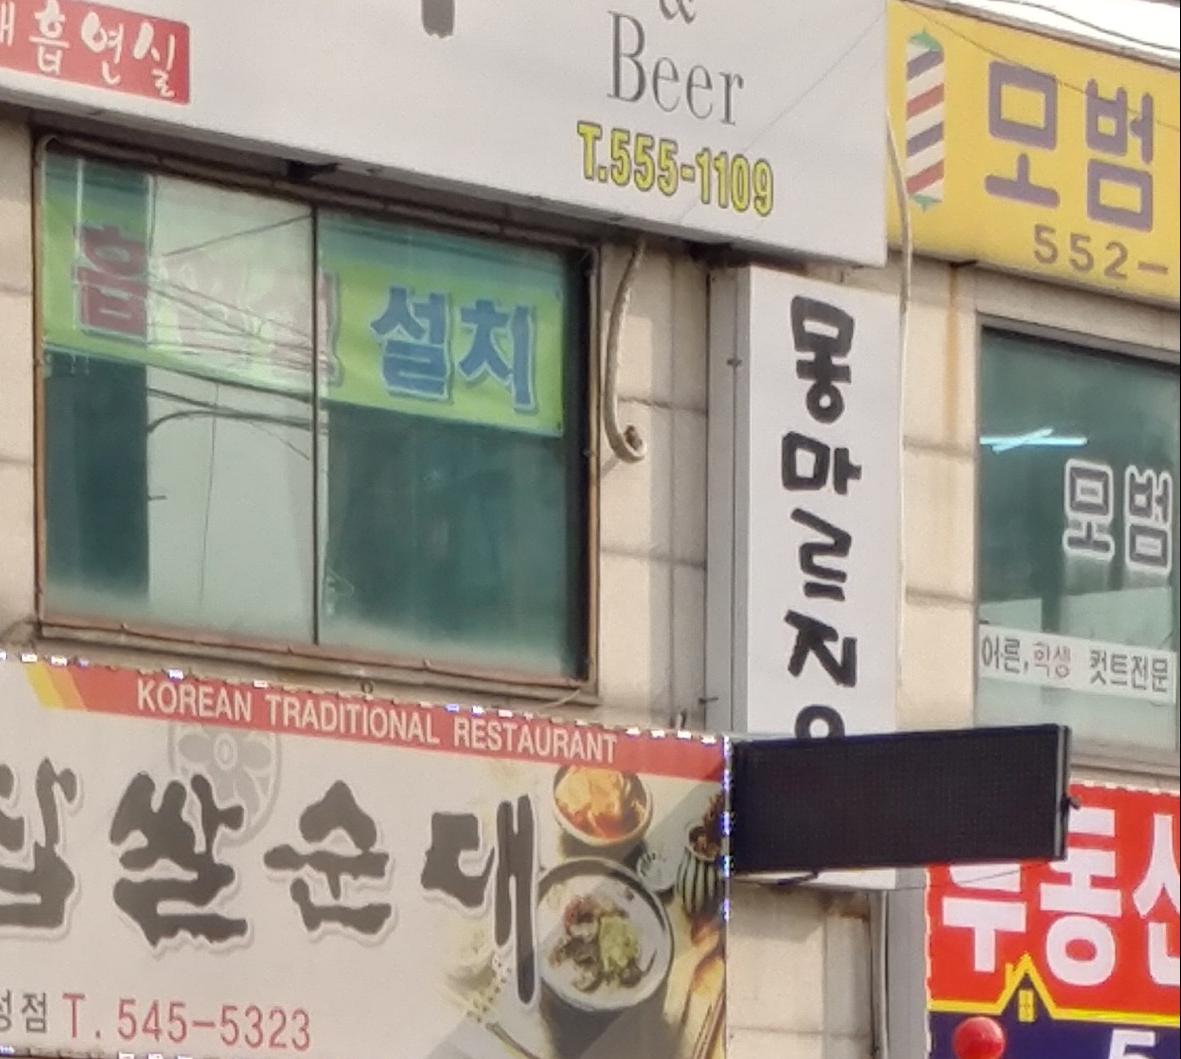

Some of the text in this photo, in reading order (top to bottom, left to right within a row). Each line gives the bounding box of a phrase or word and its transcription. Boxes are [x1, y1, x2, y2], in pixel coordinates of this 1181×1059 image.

[608, 11, 744, 126] Beer
[577, 121, 774, 217] T.555-1109
[984, 60, 1154, 233] 모범
[370, 284, 538, 413] 설치
[1063, 457, 1172, 574] 모범
[137, 679, 618, 763] KOREAN TRADITIONAL RESTAURANT
